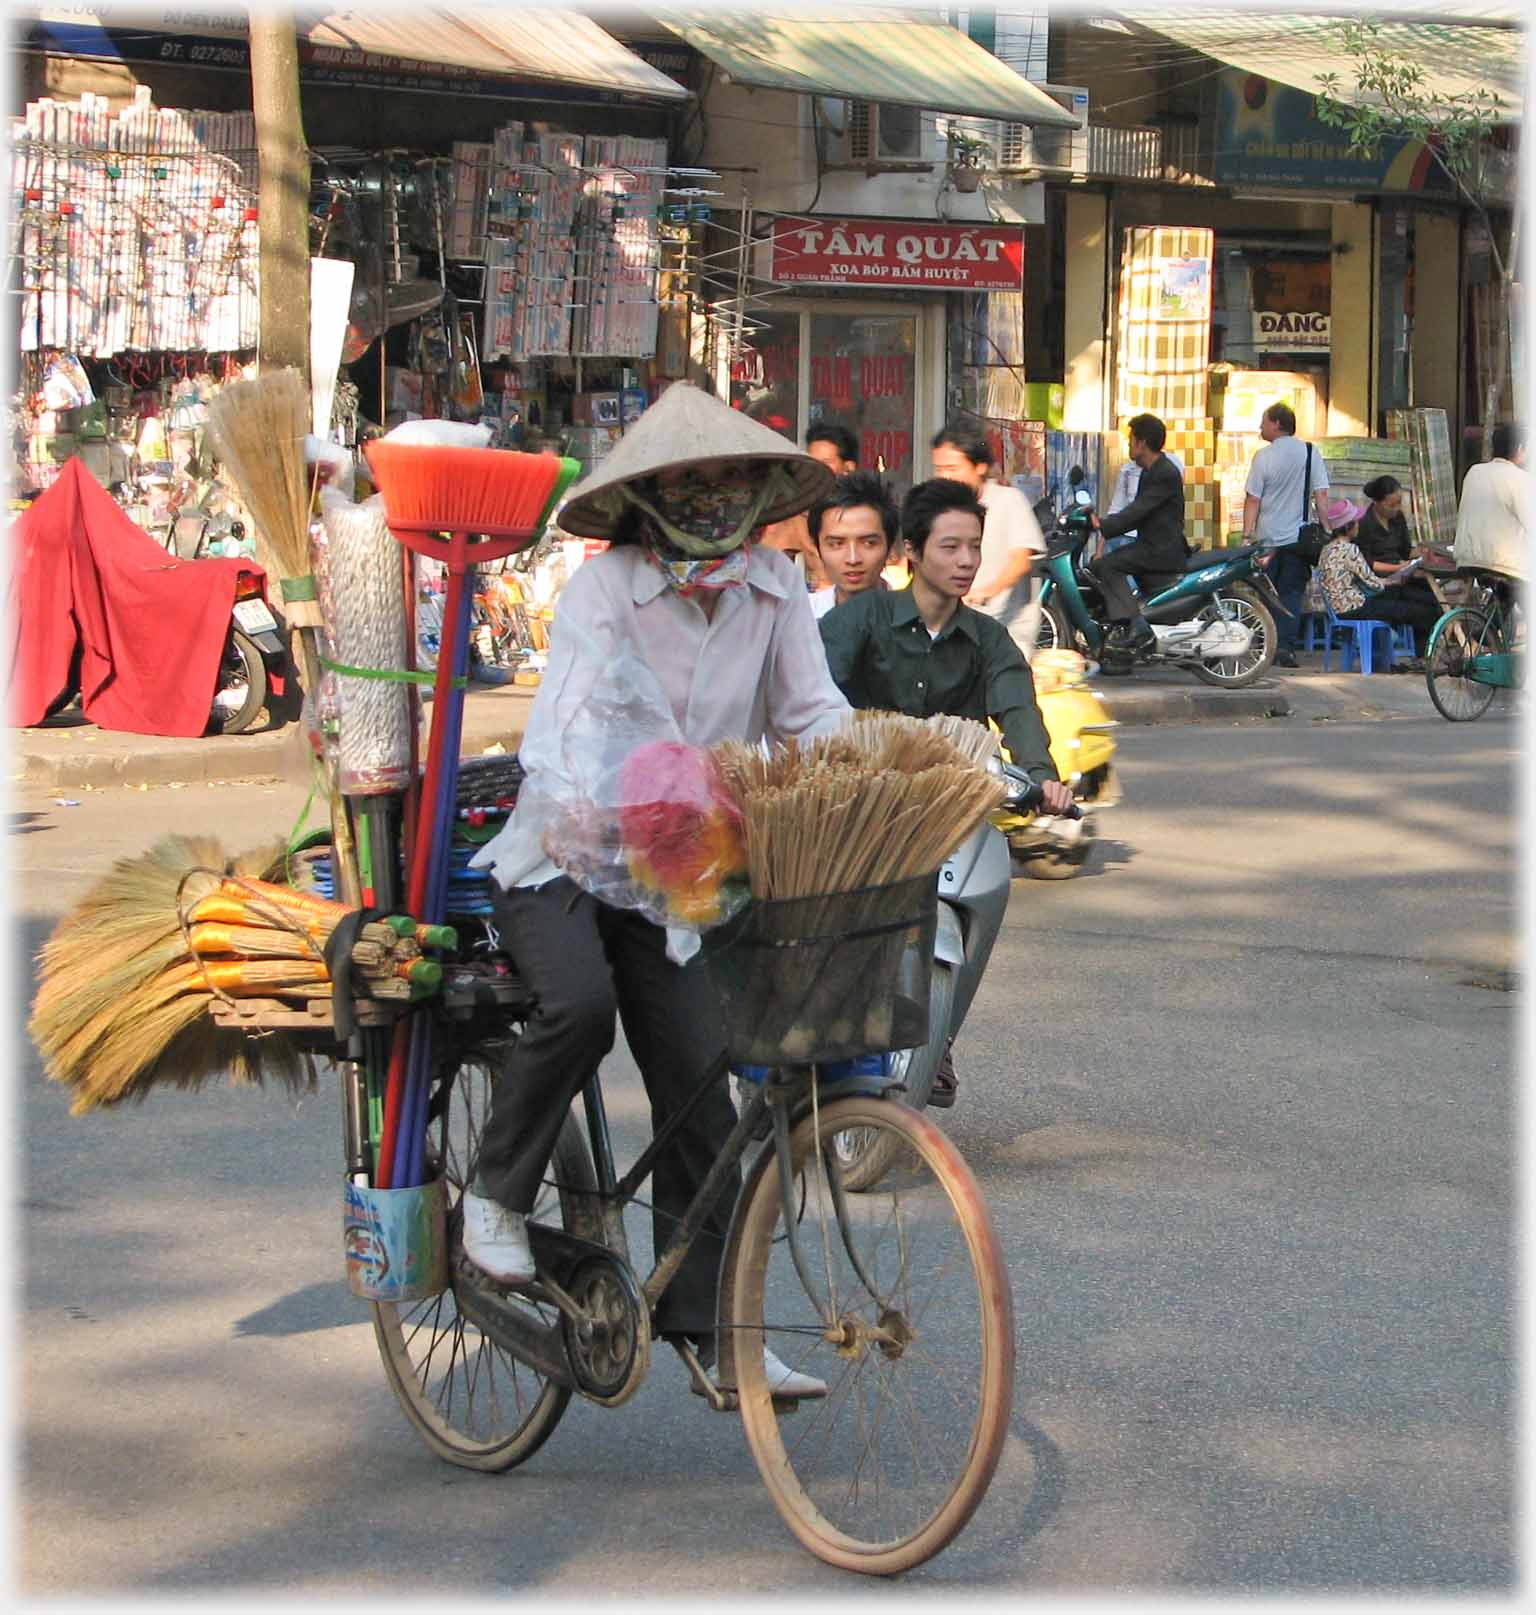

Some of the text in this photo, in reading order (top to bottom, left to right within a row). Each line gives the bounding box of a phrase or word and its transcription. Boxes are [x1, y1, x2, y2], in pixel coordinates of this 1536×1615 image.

[798, 222, 1002, 264] TẨM QUẤT
[830, 263, 859, 275] XOA
[924, 267, 969, 281] HUYỆT
